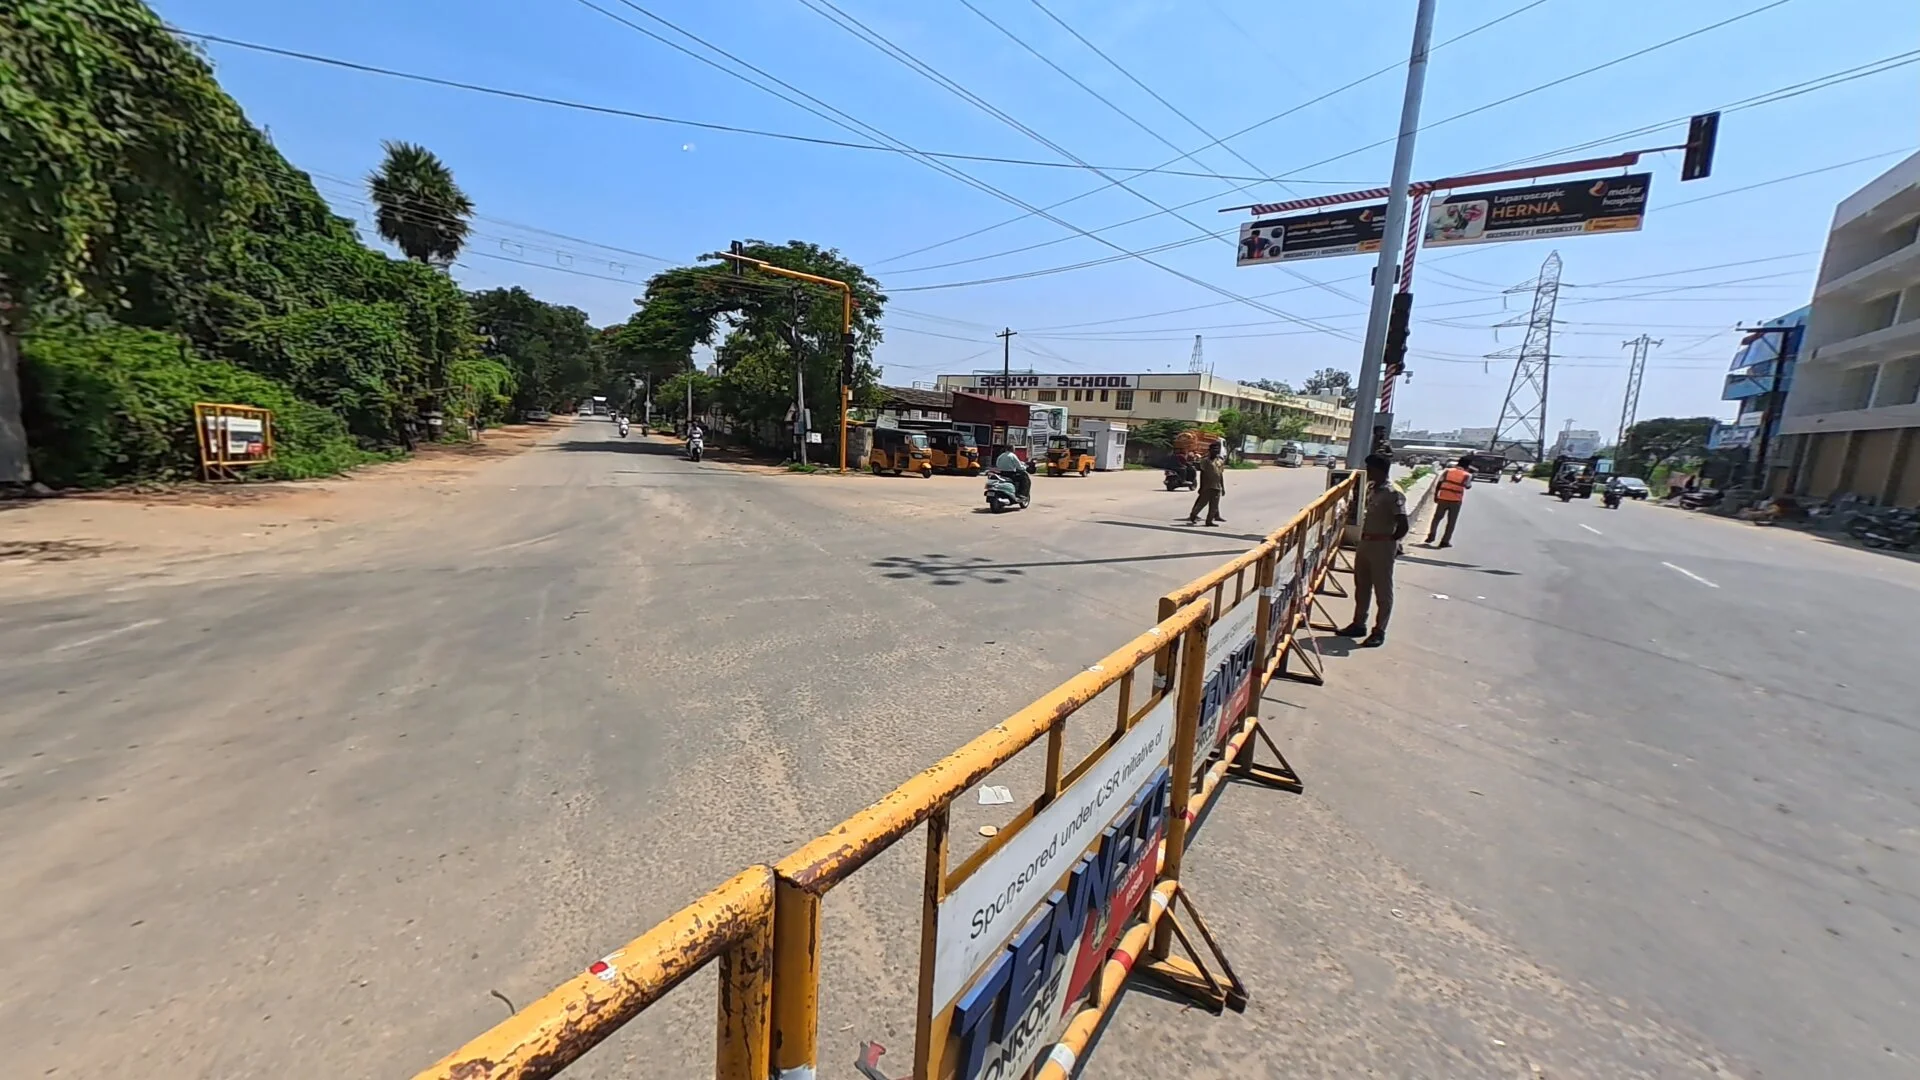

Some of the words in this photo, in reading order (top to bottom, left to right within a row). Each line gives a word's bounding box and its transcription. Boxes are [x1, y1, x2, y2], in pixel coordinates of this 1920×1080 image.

[1494, 188, 1566, 204] Laparoscopic
[1492, 201, 1561, 218] HERNIA
[980, 376, 1039, 387] SISHYA
[1057, 376, 1132, 388] SCHOOL
[970, 833, 1058, 940] Sponsored
[1061, 802, 1095, 847] under
[1096, 769, 1121, 809] CSR
[1121, 740, 1154, 784] initiative
[1154, 724, 1165, 747] of
[984, 964, 1064, 1080] ONROE
